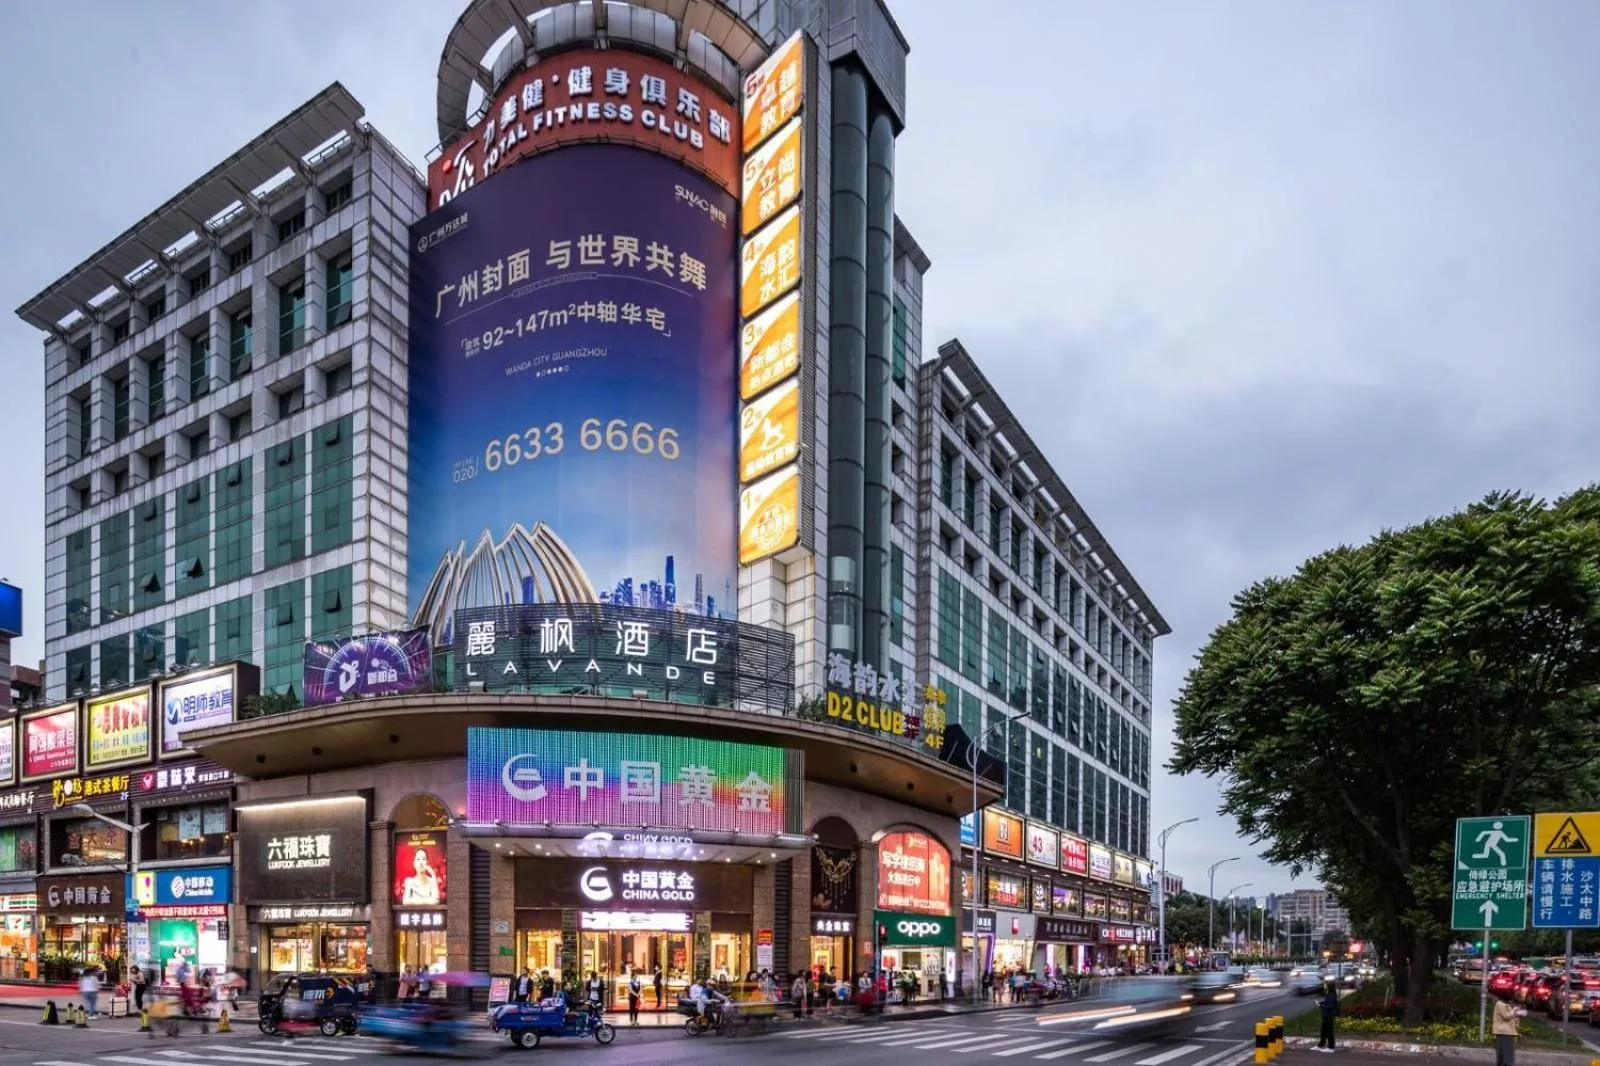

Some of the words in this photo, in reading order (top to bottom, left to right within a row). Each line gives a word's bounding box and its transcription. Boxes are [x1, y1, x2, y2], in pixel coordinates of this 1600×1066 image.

[482, 125, 529, 176] TOTAL
[533, 102, 634, 132] FITNESS
[641, 109, 704, 150] CLUB
[435, 247, 530, 318] 广州封面
[545, 233, 707, 292] 与世界共舞
[505, 361, 532, 377] WANDA
[533, 355, 550, 367] CITY
[552, 348, 608, 362] GUANGZHOU
[485, 422, 564, 471] 6633
[580, 418, 681, 460] 6666
[466, 658, 716, 685] LAVANDE
[183, 688, 233, 715] 明师教育
[827, 691, 853, 721] D2
[856, 700, 905, 735] CLUB
[563, 757, 773, 812] 中国黄金
[63, 885, 111, 905] 中国黄金
[622, 871, 695, 890] 中国黄金
[622, 889, 660, 901] CHINA
[661, 889, 695, 901] GOLD
[1456, 880, 1524, 893] 应急避护场所
[1540, 858, 1555, 920] 车辆请慢行
[1579, 870, 1594, 920] 沙太中路
[1456, 892, 1493, 900] EMERGENCY
[1496, 892, 1525, 900] SHELTER
